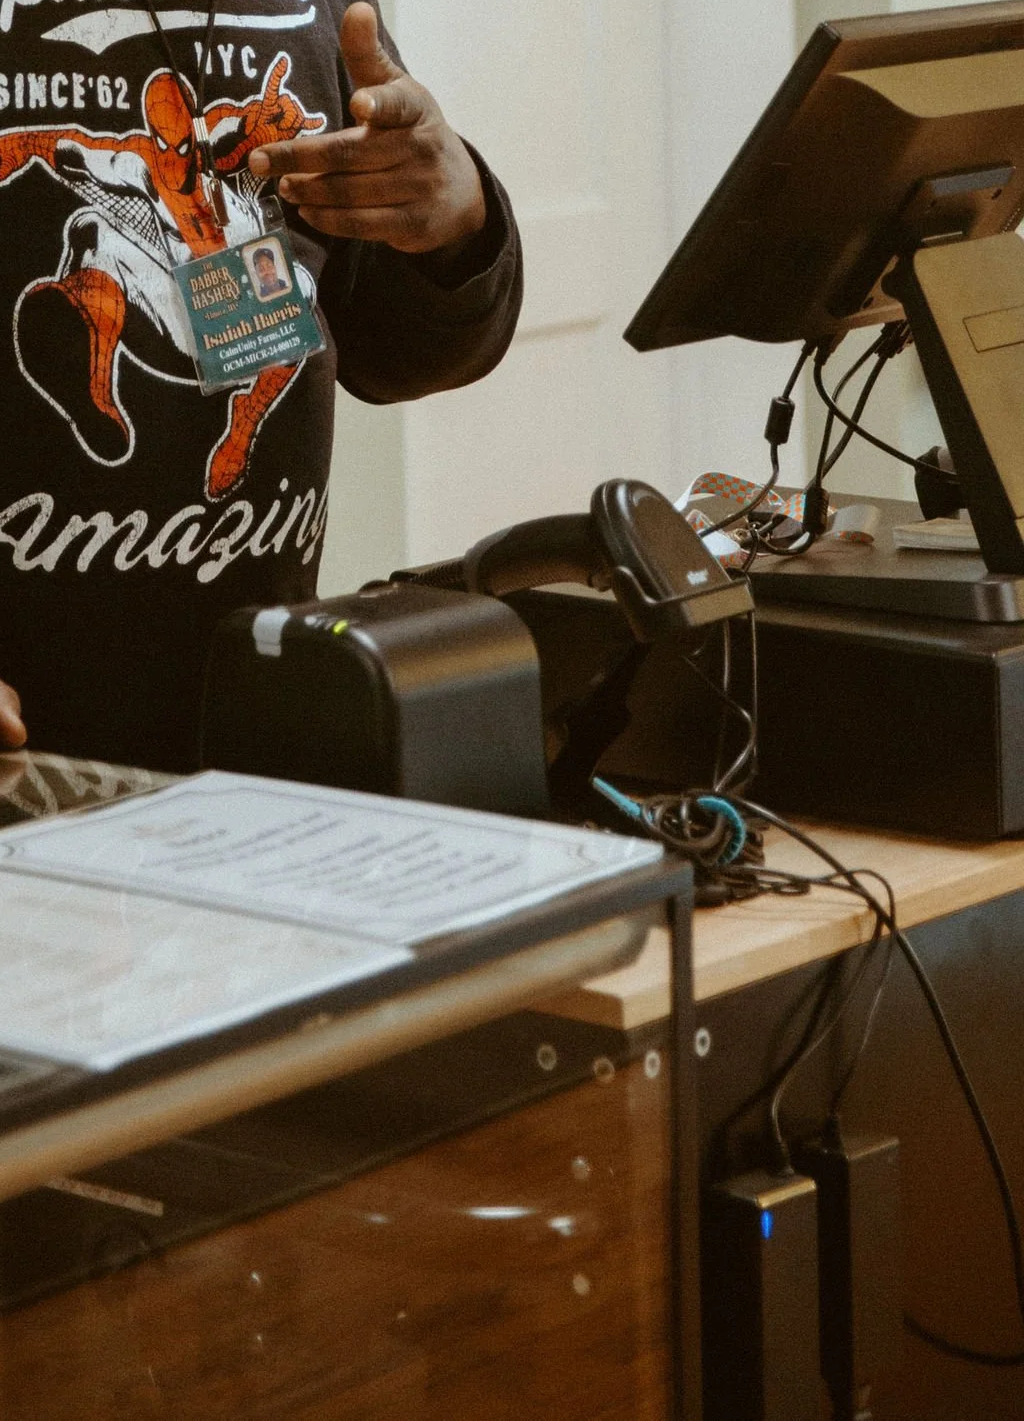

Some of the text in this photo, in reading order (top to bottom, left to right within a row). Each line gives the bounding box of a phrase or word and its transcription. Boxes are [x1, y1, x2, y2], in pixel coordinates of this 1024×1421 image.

[190, 266, 235, 292] DABBER
[192, 280, 240, 310] HASHERY
[203, 320, 252, 350] Isaiah
[253, 302, 301, 331] Harris
[279, 322, 296, 336] LLC
